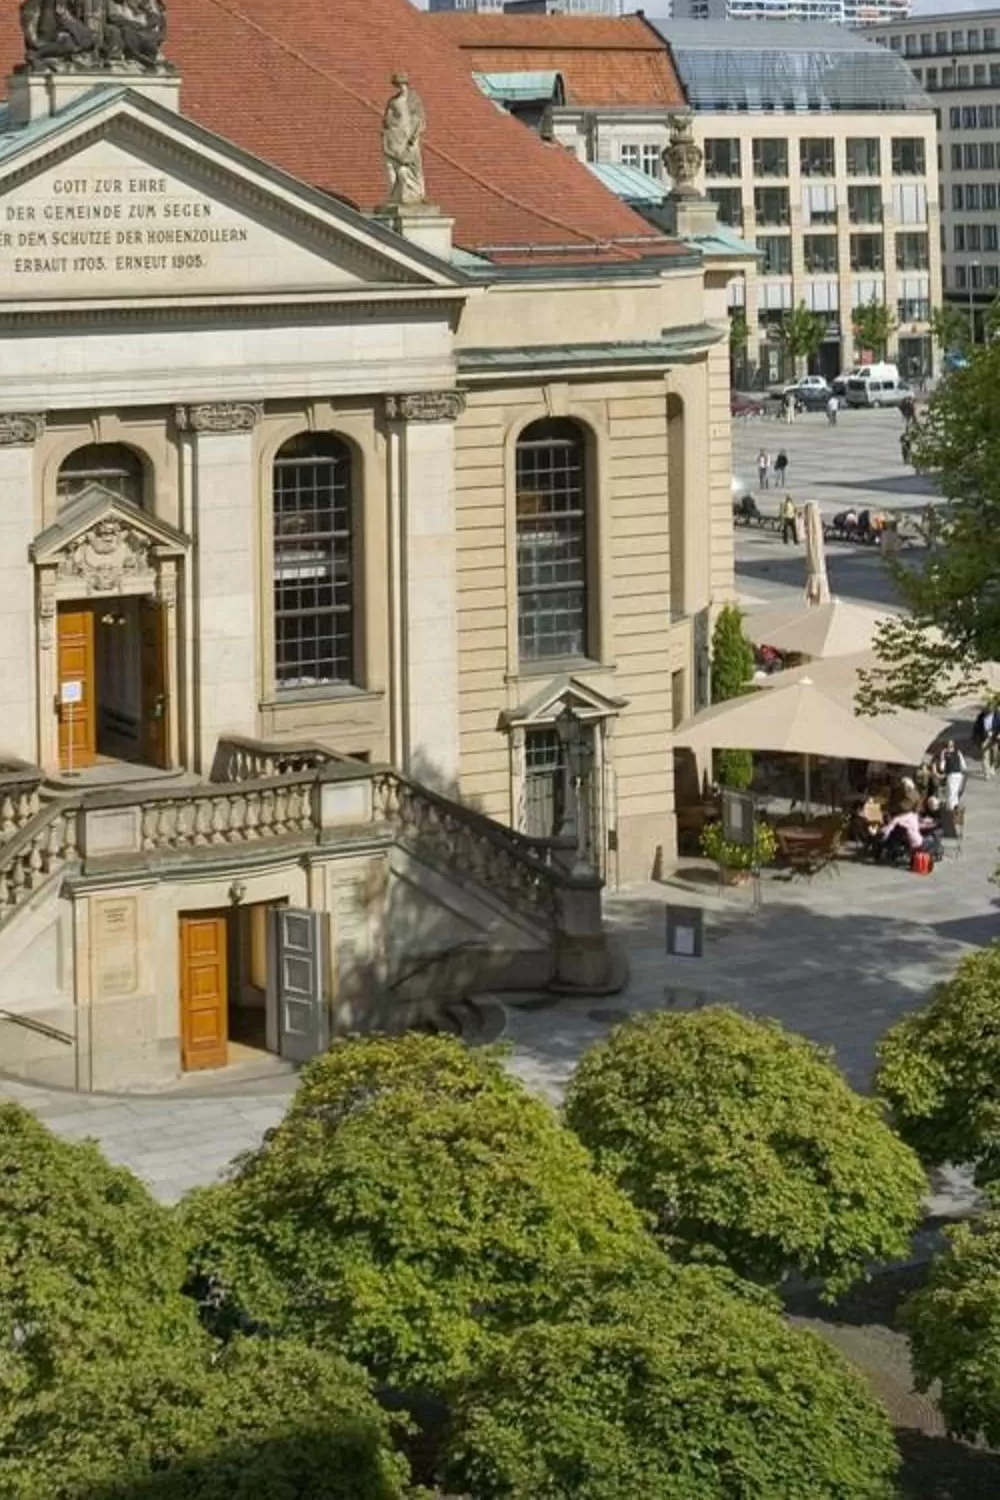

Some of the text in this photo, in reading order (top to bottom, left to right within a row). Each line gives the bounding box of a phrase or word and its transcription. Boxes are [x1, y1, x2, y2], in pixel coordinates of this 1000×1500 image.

[53, 178, 167, 193] GOTT ZUR EHRE
[6, 203, 211, 220] DER GEMEINDE ZUM SEGEN
[18, 231, 47, 246] DEM
[51, 231, 111, 245] SCHUTZE
[116, 230, 143, 244] DER
[147, 228, 248, 244] HOHENZOLLERN
[14, 257, 68, 273] ERBAUT
[115, 255, 168, 270] ERNEUT
